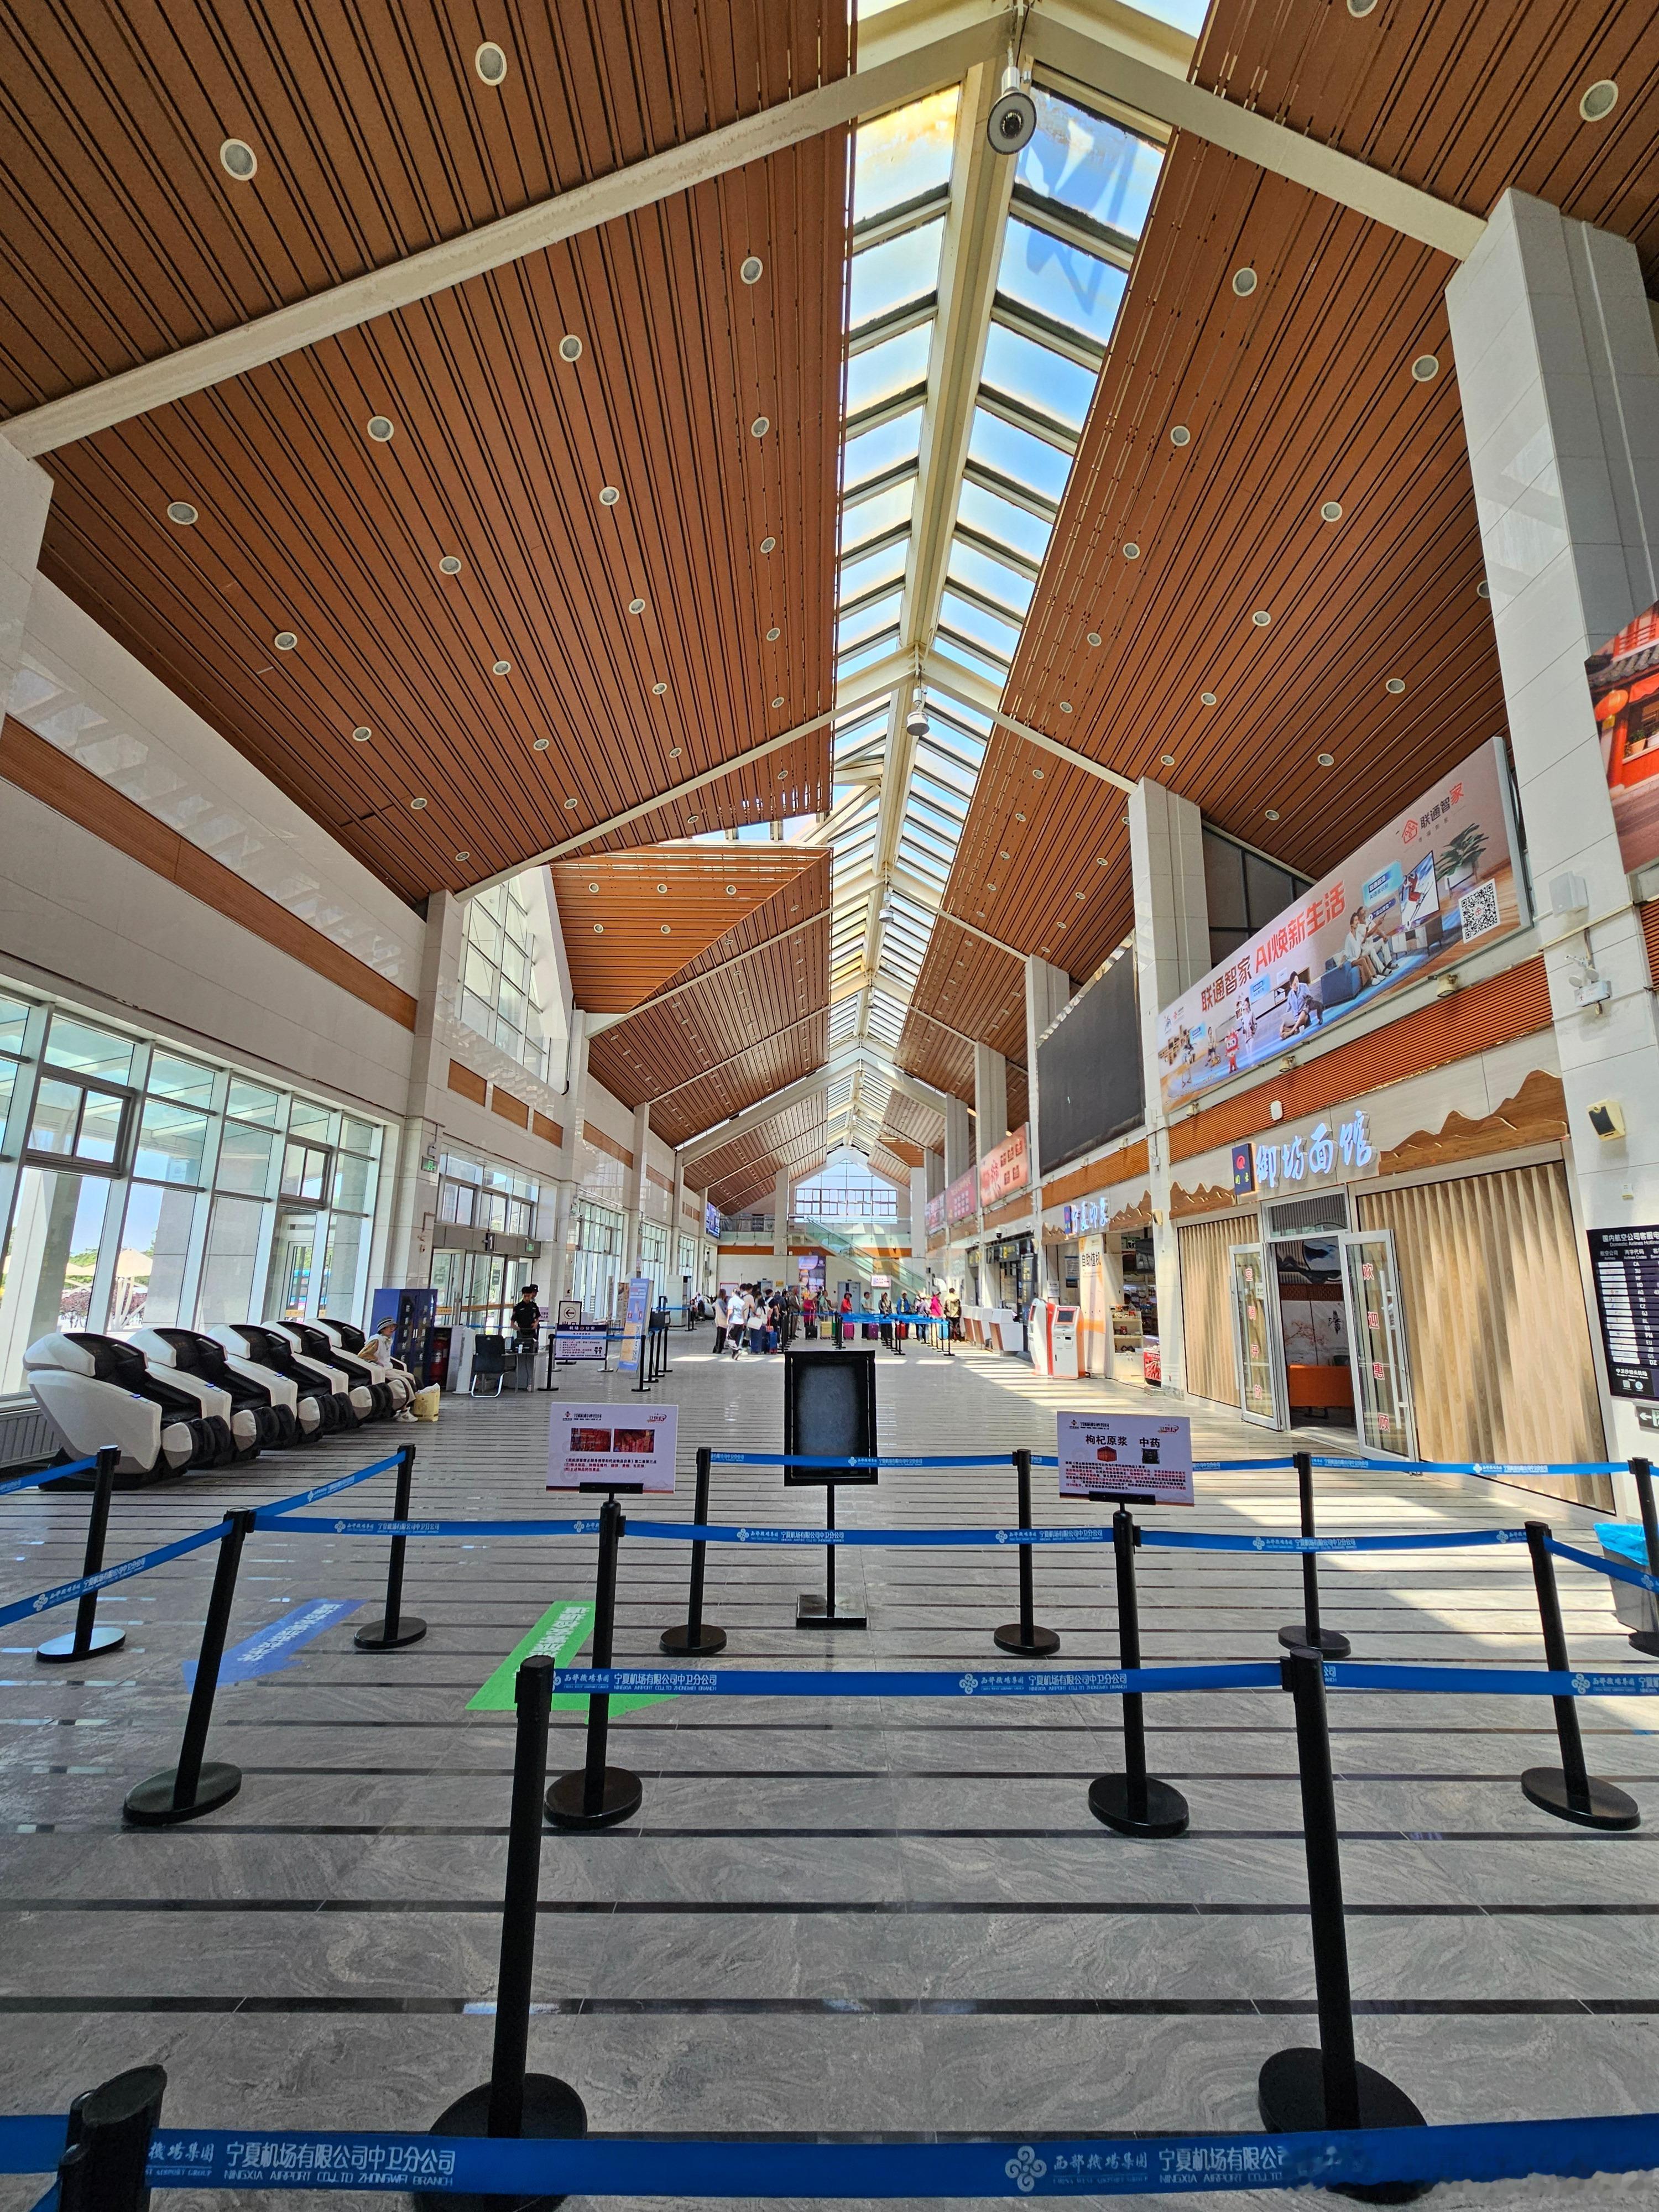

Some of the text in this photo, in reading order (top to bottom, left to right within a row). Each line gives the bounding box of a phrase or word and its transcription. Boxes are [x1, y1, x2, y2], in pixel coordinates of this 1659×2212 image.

[1420, 782, 1464, 829] 联通智家
[1201, 880, 1345, 1012] 联通智家 AI焕新生活
[489, 1235, 493, 1249] 1
[1082, 1252, 1101, 1267] 自助值机
[1363, 1263, 1390, 1432] 欢迎惠顾
[1086, 1434, 1160, 1448] 枸杞原浆 中药
[614, 1673, 717, 1686] 宁夏机场有限公司中卫分公司
[1029, 1673, 1127, 1686] 宁夏机场有限公司中卫分公司
[226, 2141, 456, 2175] 宁夏机场有限公司中卫分公司
[224, 2169, 263, 2180] NINGXIA
[270, 2171, 310, 2181] AIRPORT
[358, 2173, 408, 2184] ZHONGWEI
[413, 2176, 453, 2187] BRANCH
[1160, 2173, 1197, 2183] NINGXIA
[1203, 2173, 1243, 2183] AIRPORT
